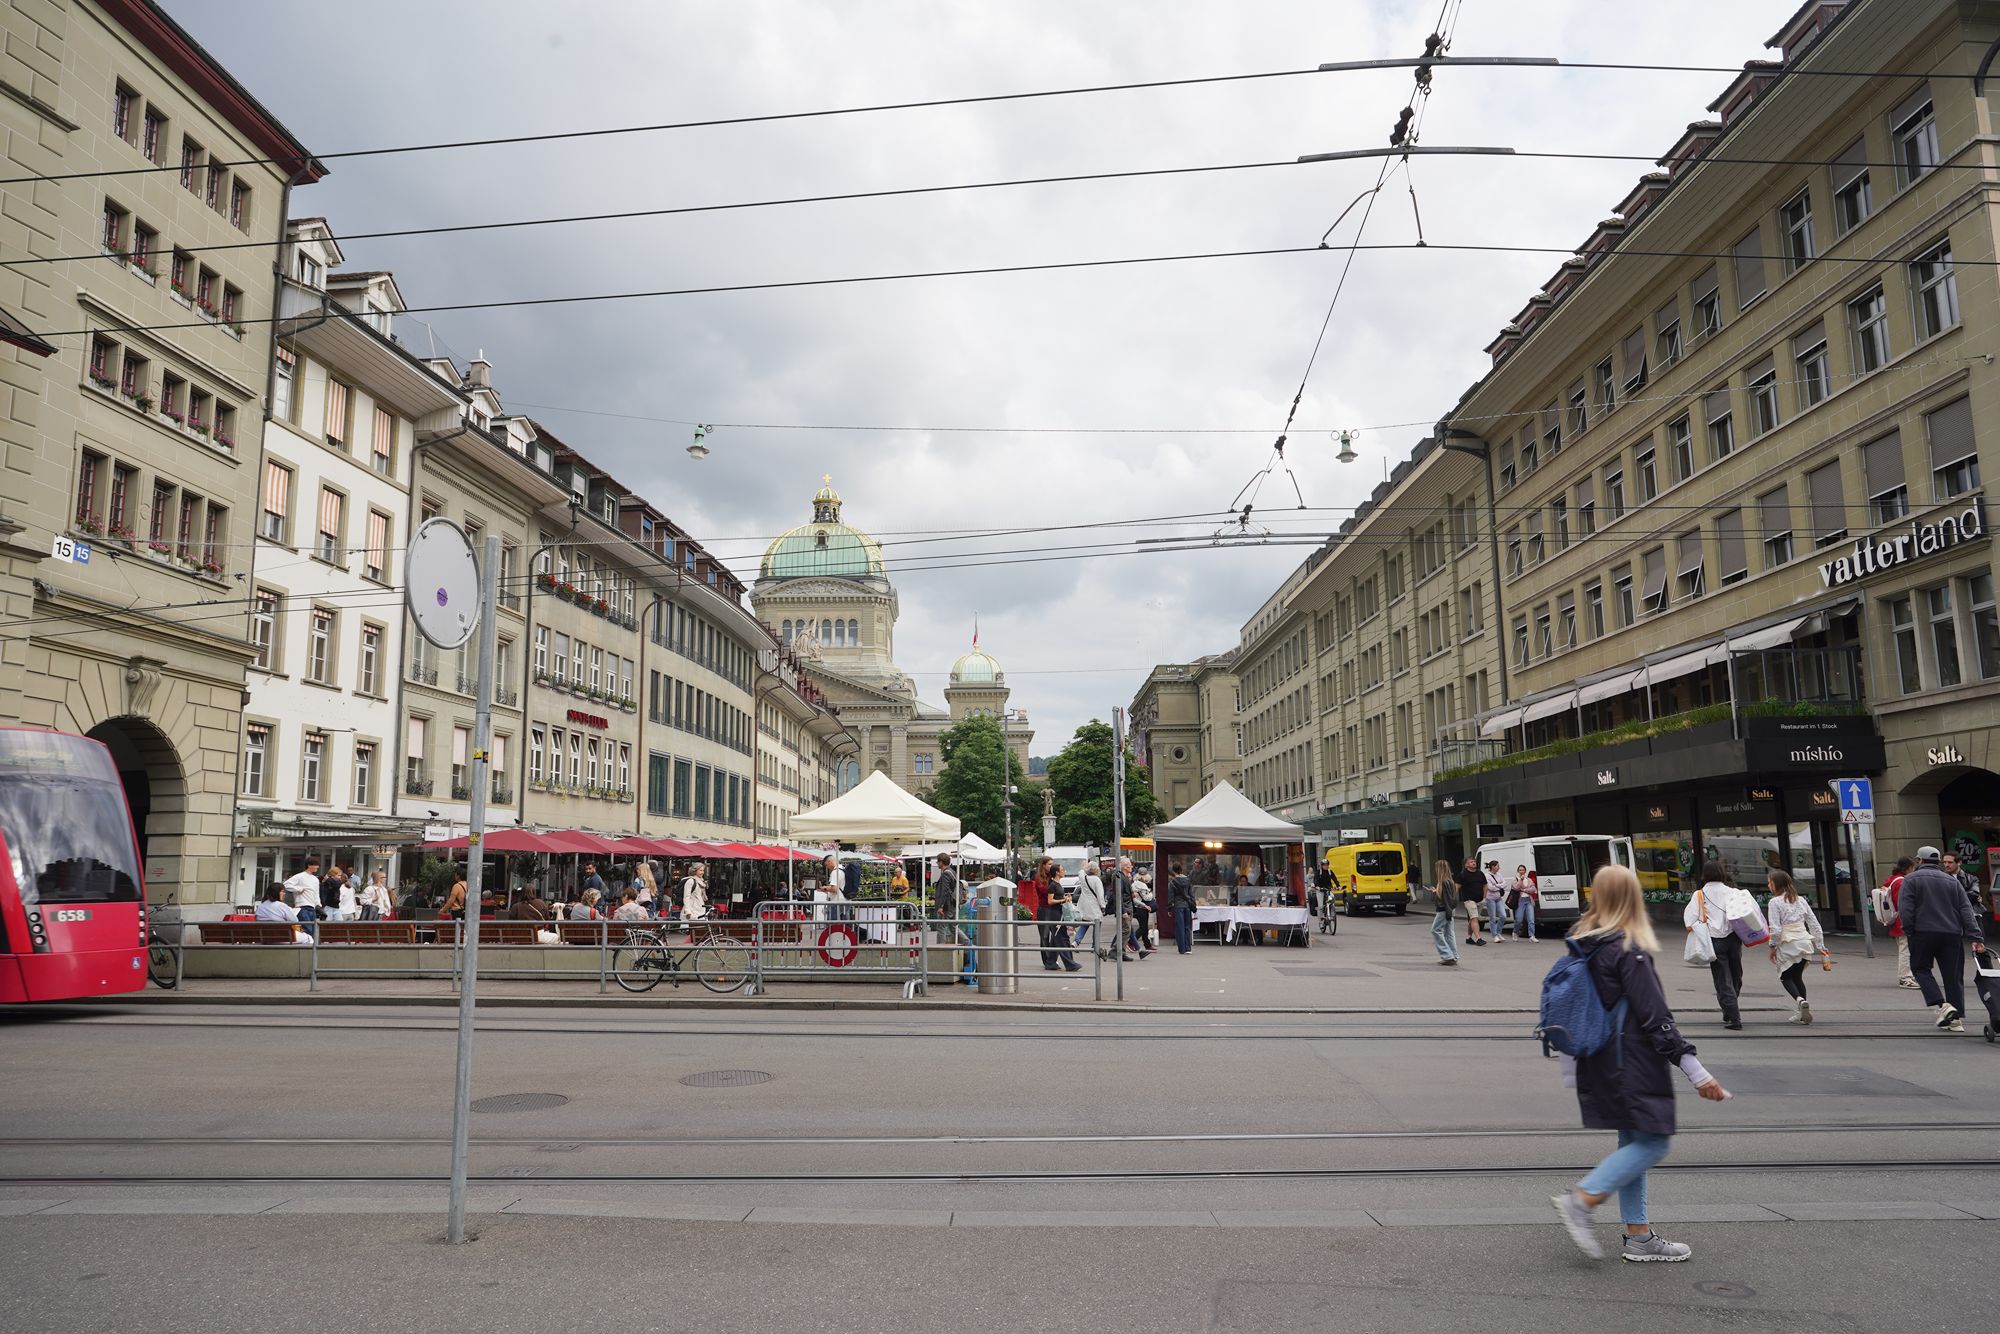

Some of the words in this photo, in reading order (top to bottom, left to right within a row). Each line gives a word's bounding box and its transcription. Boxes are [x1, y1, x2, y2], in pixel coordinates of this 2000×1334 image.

[56, 541, 71, 557] 15
[1818, 497, 1981, 588] vatterland
[76, 546, 89, 560] 15
[1927, 745, 1963, 766] Salt.
[1597, 770, 1616, 786] Salt.
[1752, 789, 1774, 798] Salt.
[1813, 791, 1836, 805] Salt.
[1650, 807, 1664, 818] Salt.
[1716, 804, 1732, 813] Home
[1733, 803, 1739, 811] of
[1740, 802, 1755, 811] Salt.
[57, 910, 86, 922] 658
